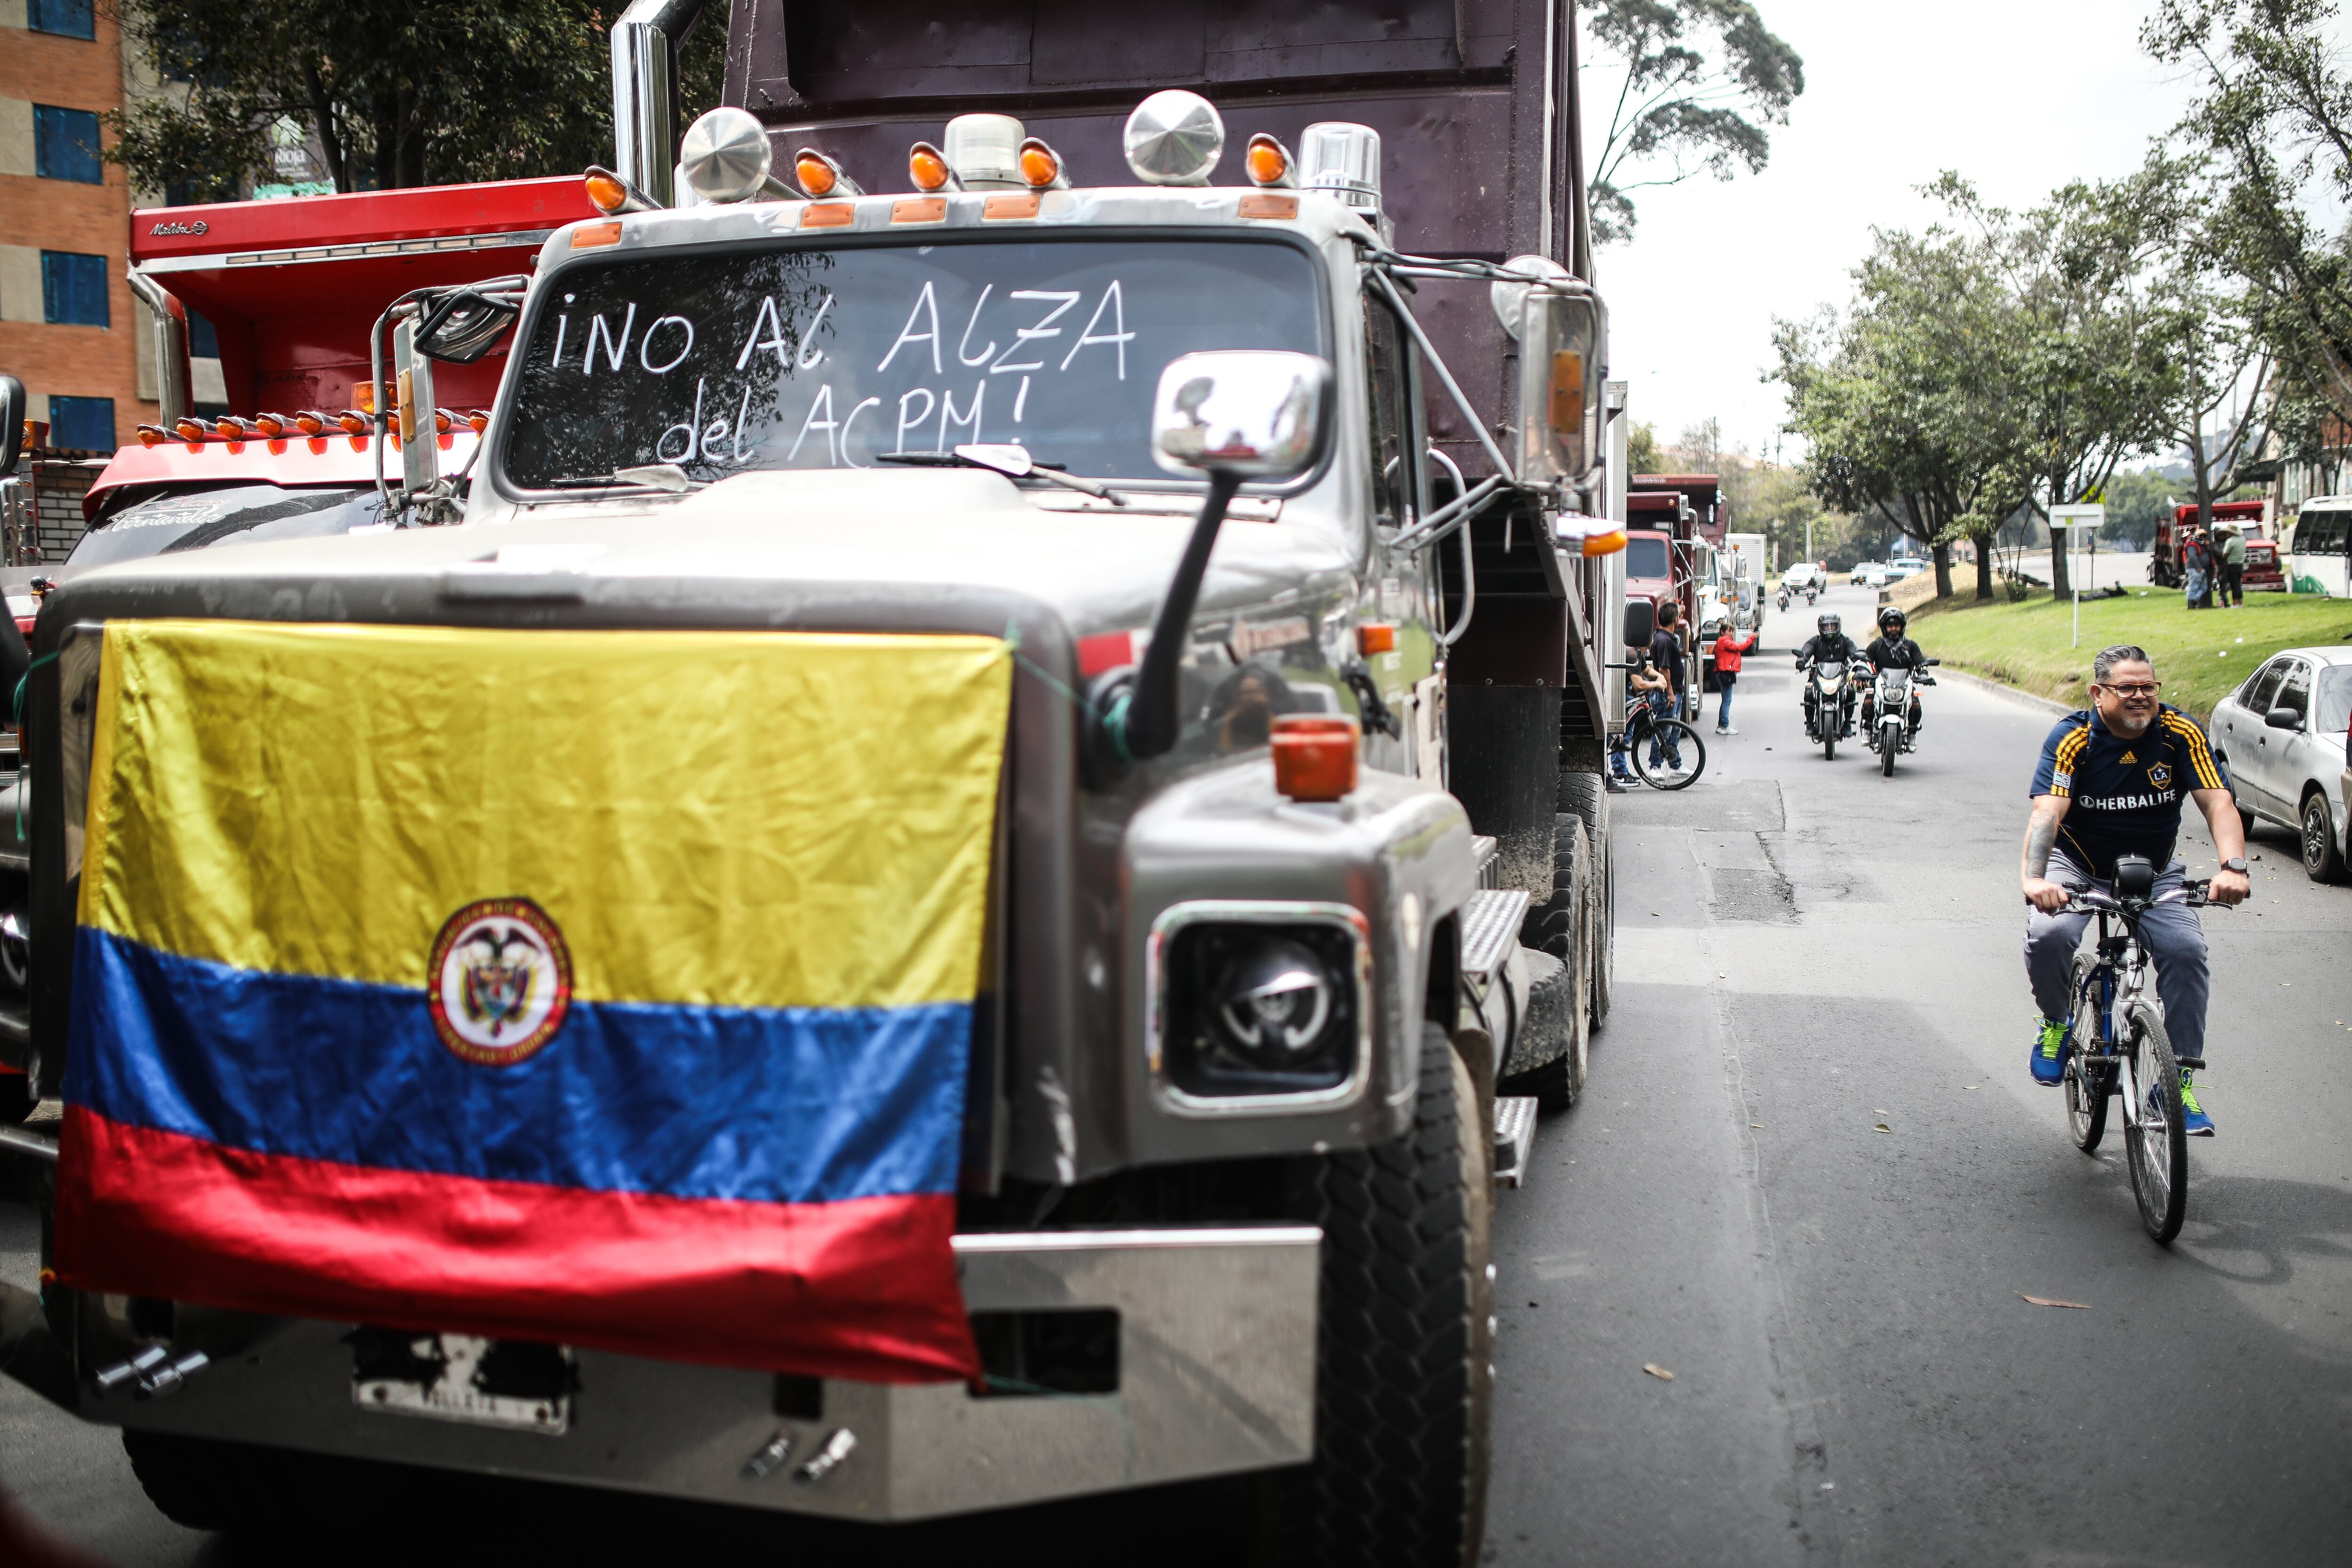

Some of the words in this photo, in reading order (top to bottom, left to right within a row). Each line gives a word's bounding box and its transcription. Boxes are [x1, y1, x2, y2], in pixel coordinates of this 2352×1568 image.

[149, 221, 193, 236] Malibu
[876, 279, 1137, 382] ALZA
[656, 377, 754, 464] del
[2154, 772, 2168, 780] LA
[2096, 789, 2176, 810] HERBALIFE
